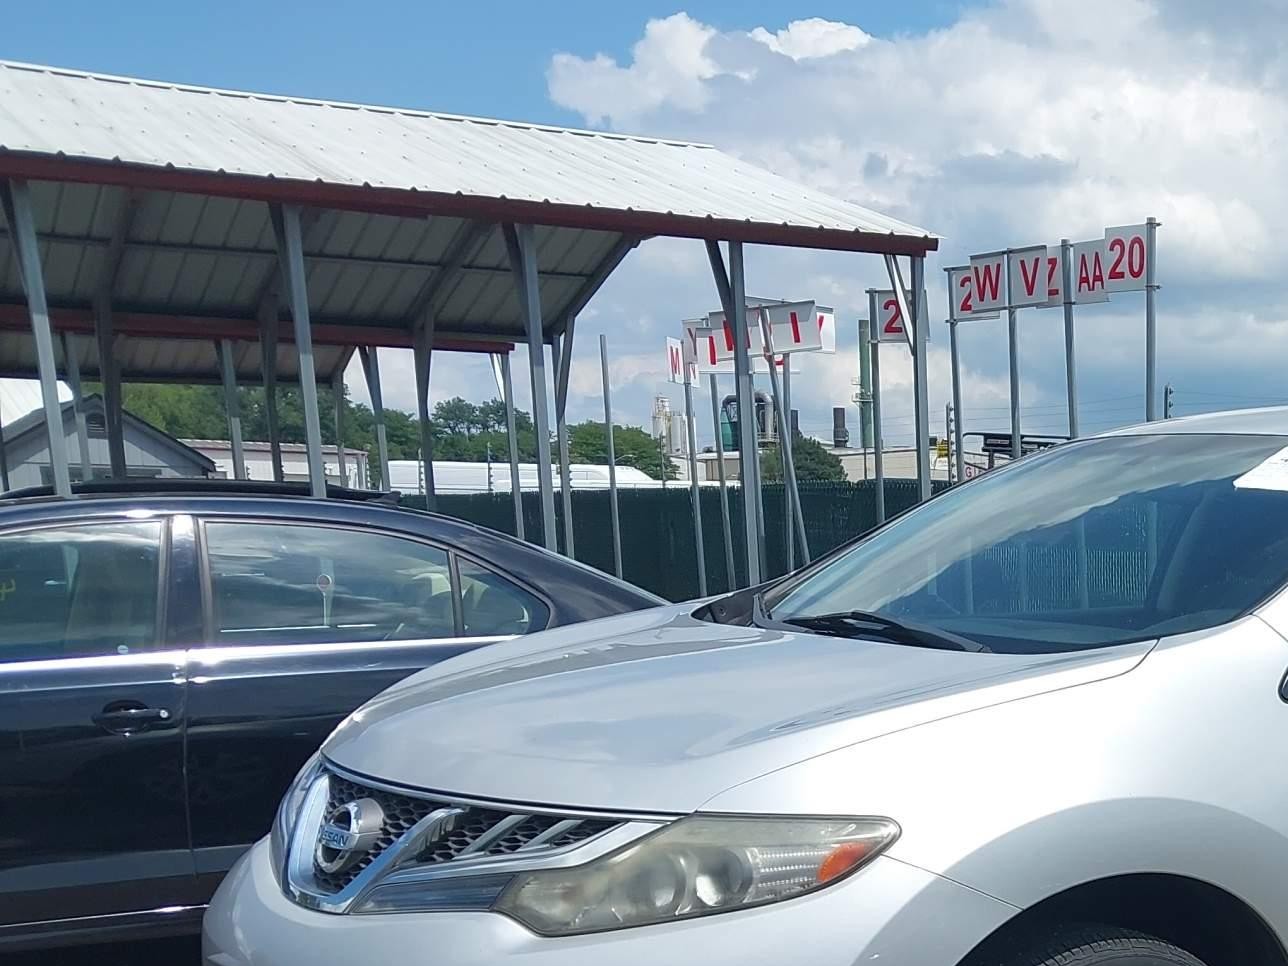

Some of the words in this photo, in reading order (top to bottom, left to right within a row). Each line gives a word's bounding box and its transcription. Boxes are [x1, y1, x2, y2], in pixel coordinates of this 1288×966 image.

[1019, 257, 1040, 296] V
[1078, 251, 1105, 293] AA
[1108, 236, 1145, 280] 20
[973, 263, 1001, 302] W
